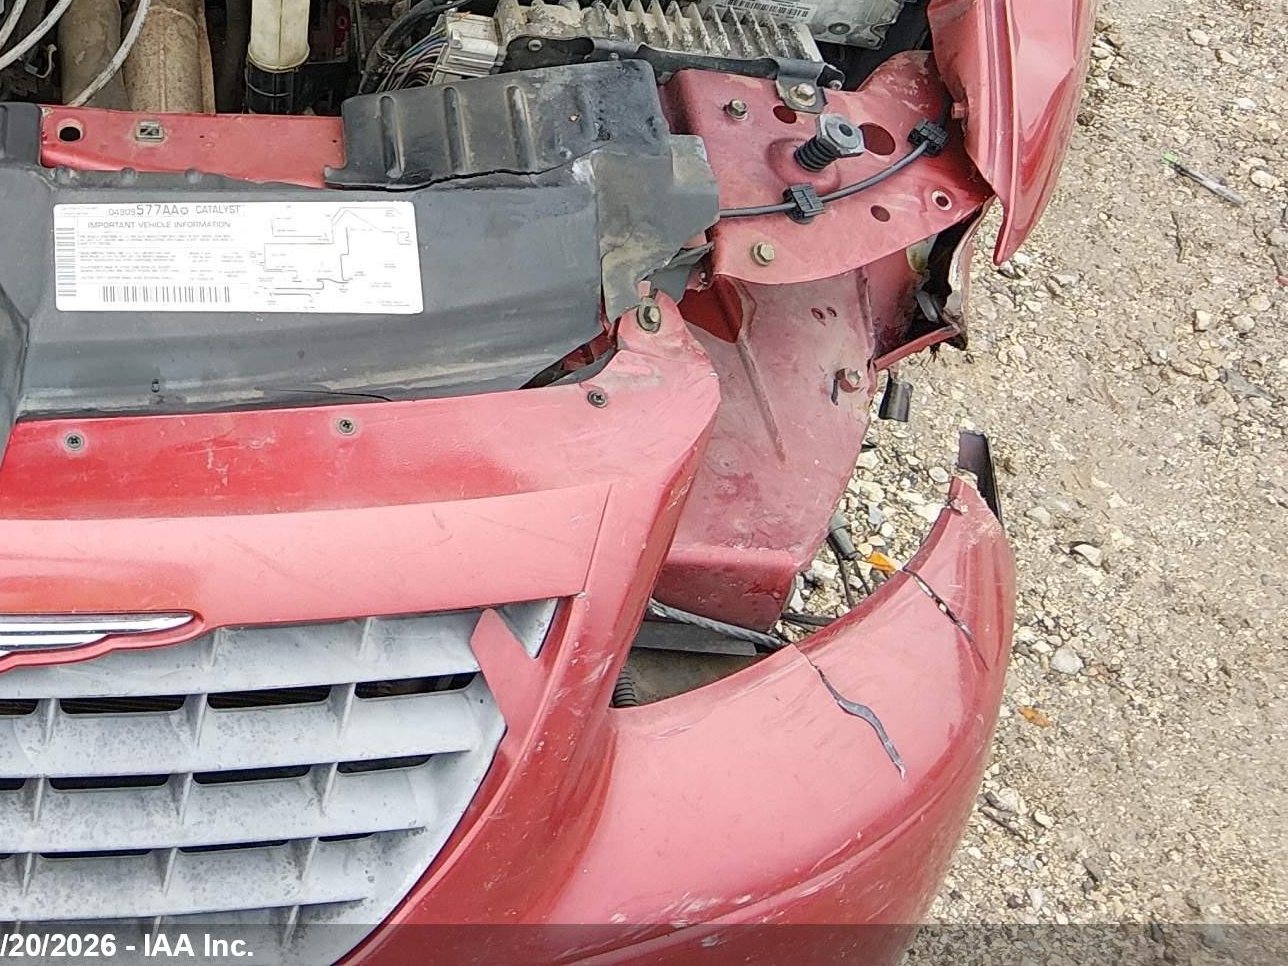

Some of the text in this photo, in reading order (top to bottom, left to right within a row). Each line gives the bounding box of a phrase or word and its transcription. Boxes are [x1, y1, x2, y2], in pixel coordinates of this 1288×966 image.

[195, 205, 241, 215] CATALYST
[87, 221, 231, 229] IMPORTANT VEHICLE INFORMATION
